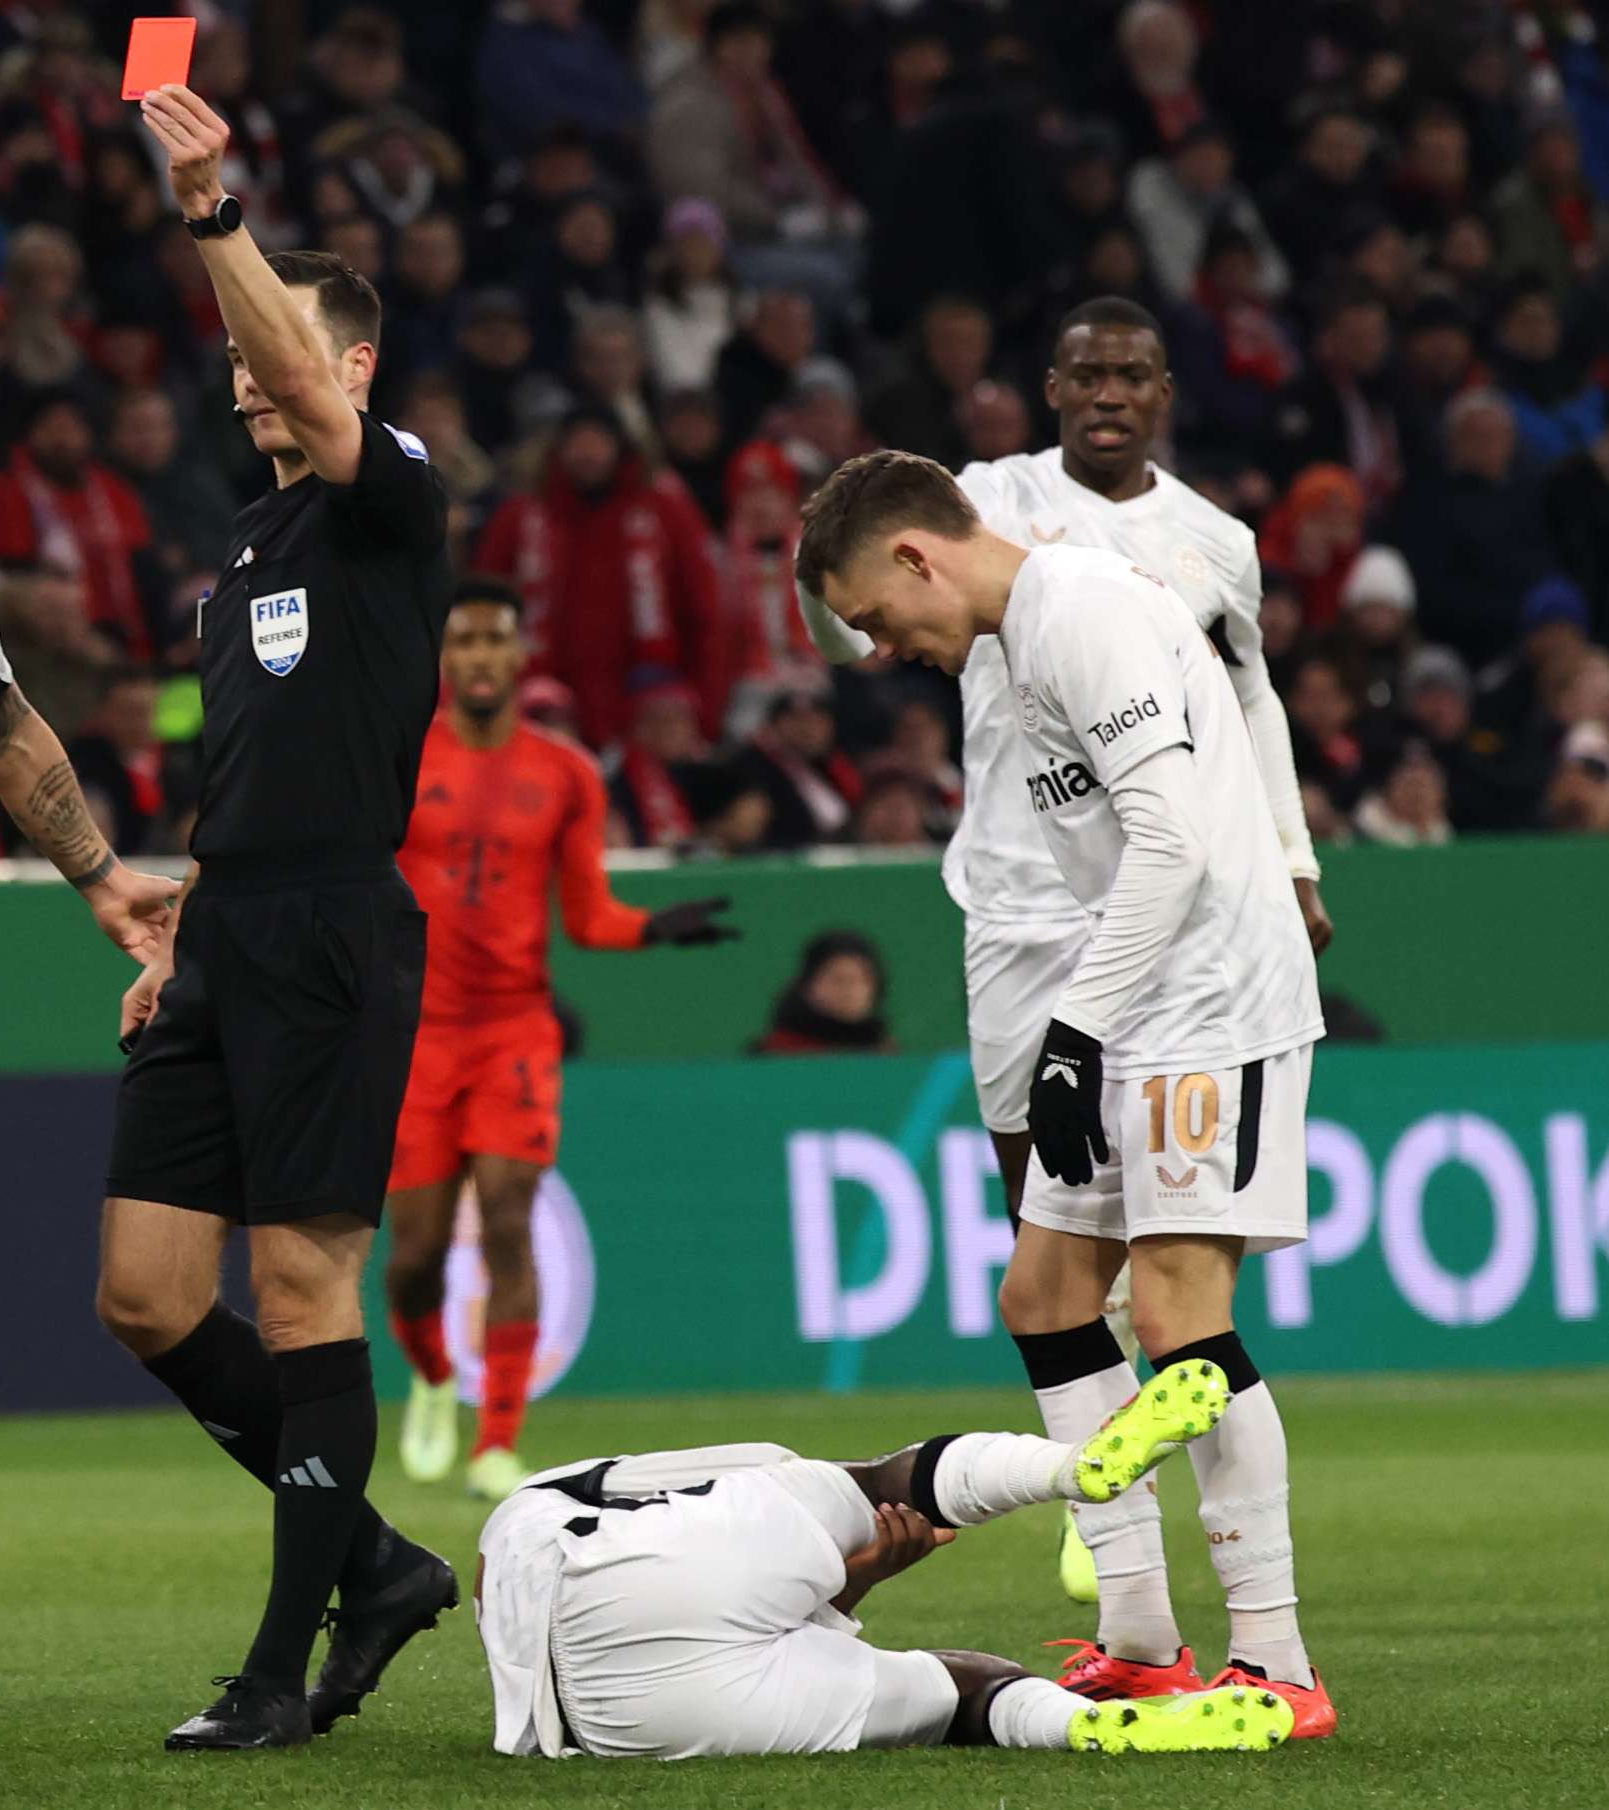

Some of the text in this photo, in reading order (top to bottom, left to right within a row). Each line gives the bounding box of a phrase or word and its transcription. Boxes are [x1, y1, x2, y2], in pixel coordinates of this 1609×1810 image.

[256, 596, 301, 622] FIFA
[258, 627, 303, 646] REFEREE
[1087, 692, 1161, 748] Talcid
[1142, 1072, 1220, 1154] 10
